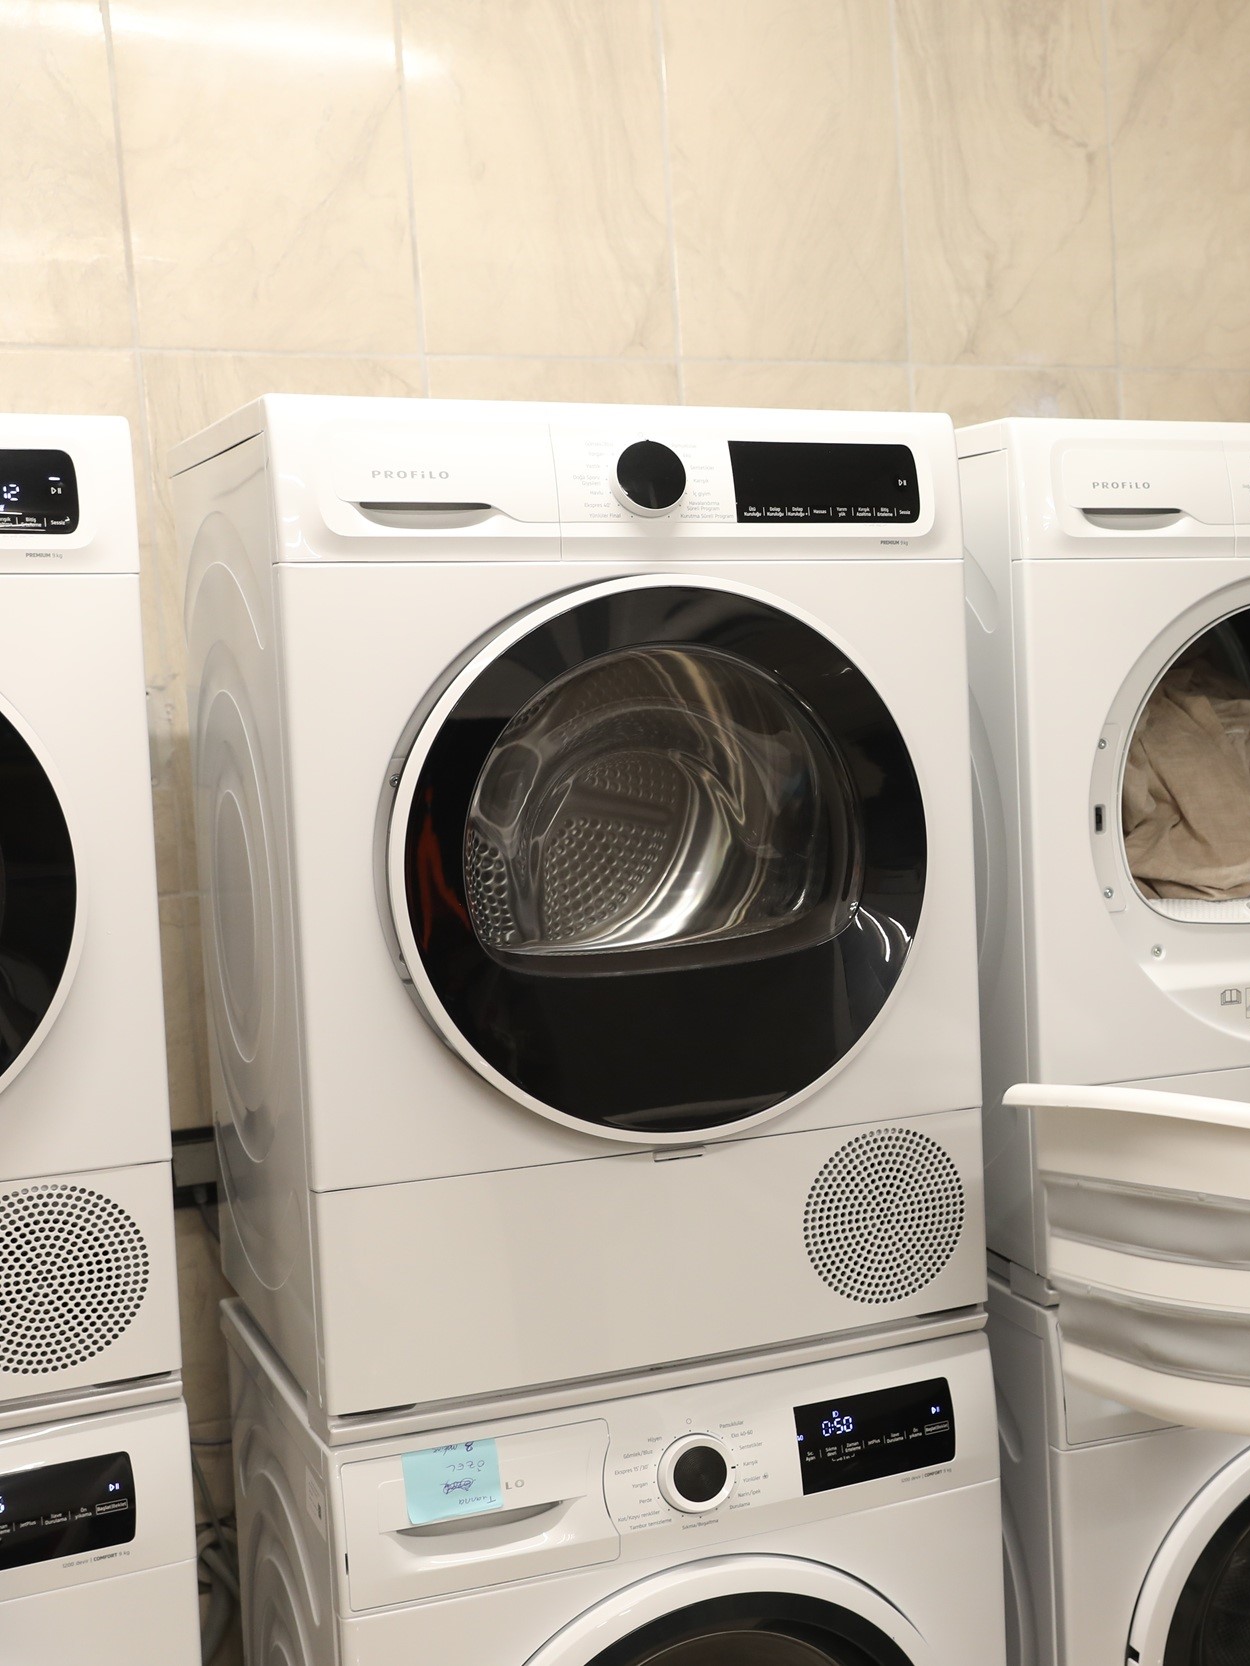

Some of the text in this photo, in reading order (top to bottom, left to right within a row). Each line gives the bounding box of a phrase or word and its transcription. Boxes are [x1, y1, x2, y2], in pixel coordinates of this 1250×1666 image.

[719, 1420, 744, 1429] Pamuklular
[821, 1416, 854, 1437] 0:50
[623, 1450, 653, 1460] Gömlek/Bluz
[614, 1468, 634, 1476] Ekspres
[924, 1470, 942, 1478] COMFORT
[632, 1481, 648, 1489] Yorgan
[729, 1501, 751, 1510] Durulama
[618, 1513, 641, 1523] Kot/Koyu
[630, 1518, 672, 1530] Tambur temizleme
[93, 1552, 118, 1562] COMFORT
